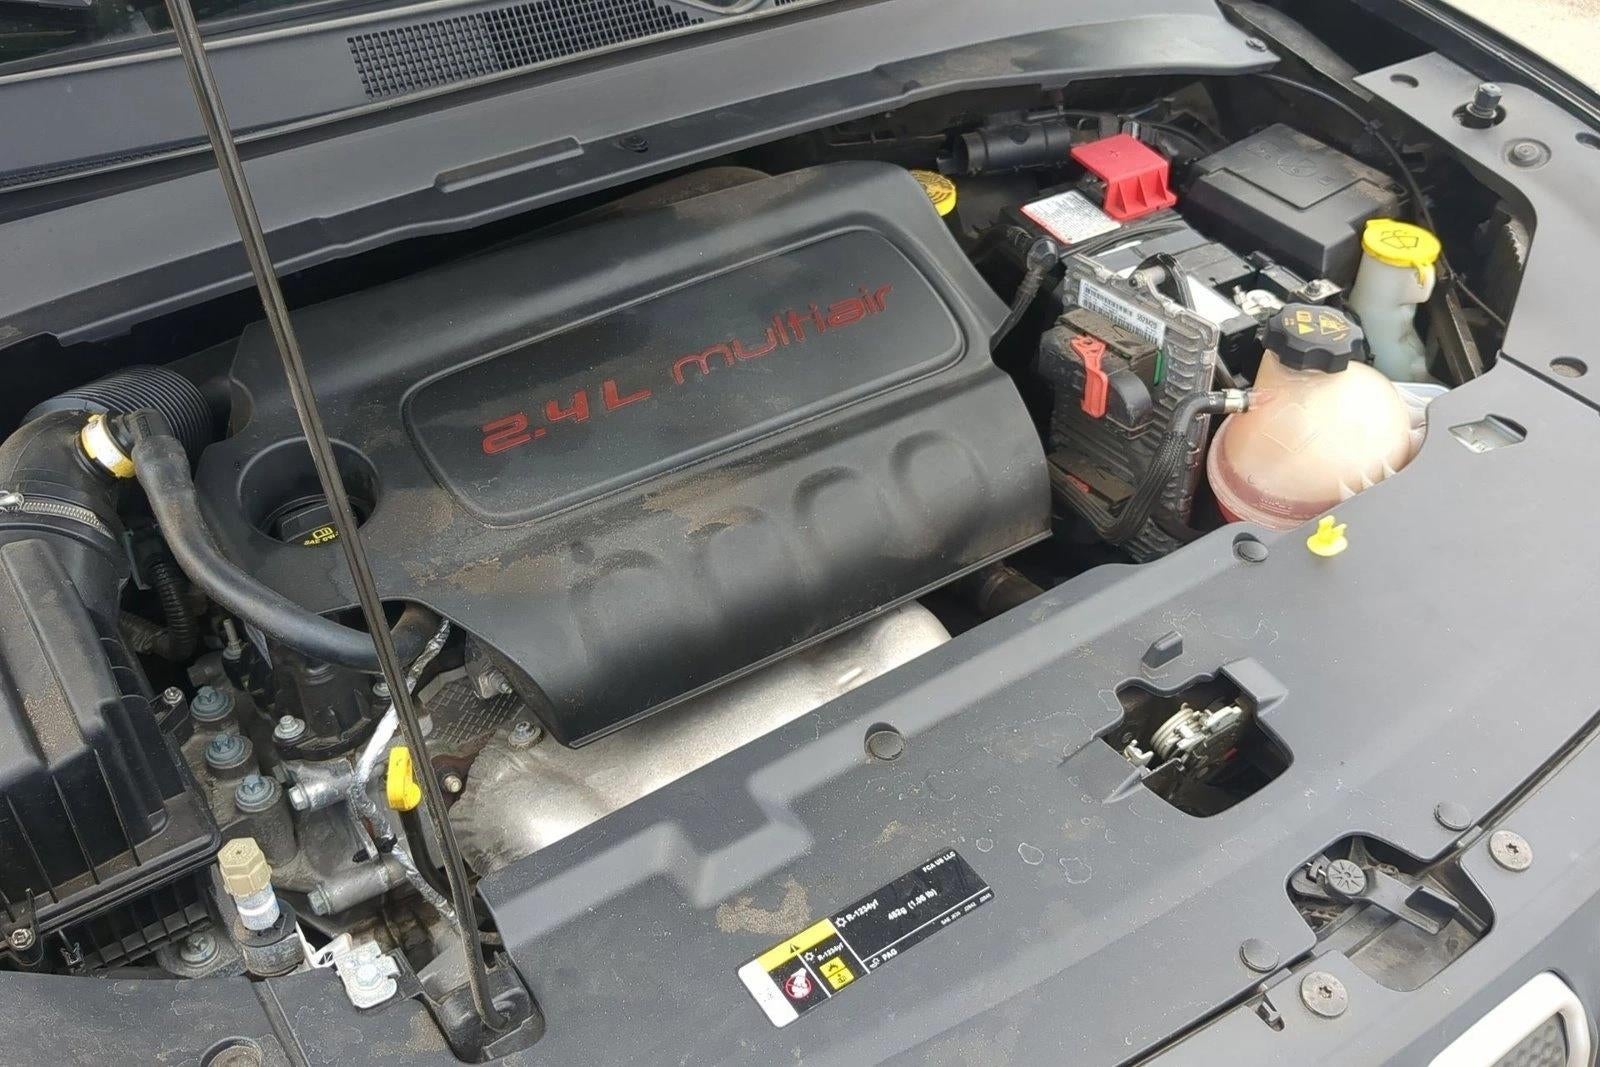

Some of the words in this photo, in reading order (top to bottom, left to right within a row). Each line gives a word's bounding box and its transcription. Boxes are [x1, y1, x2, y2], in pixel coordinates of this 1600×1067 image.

[671, 283, 893, 385] multiair
[922, 862, 936, 873] FCA
[943, 851, 956, 861] LLC
[845, 898, 879, 922] R-1234yf
[881, 948, 898, 961] PAG
